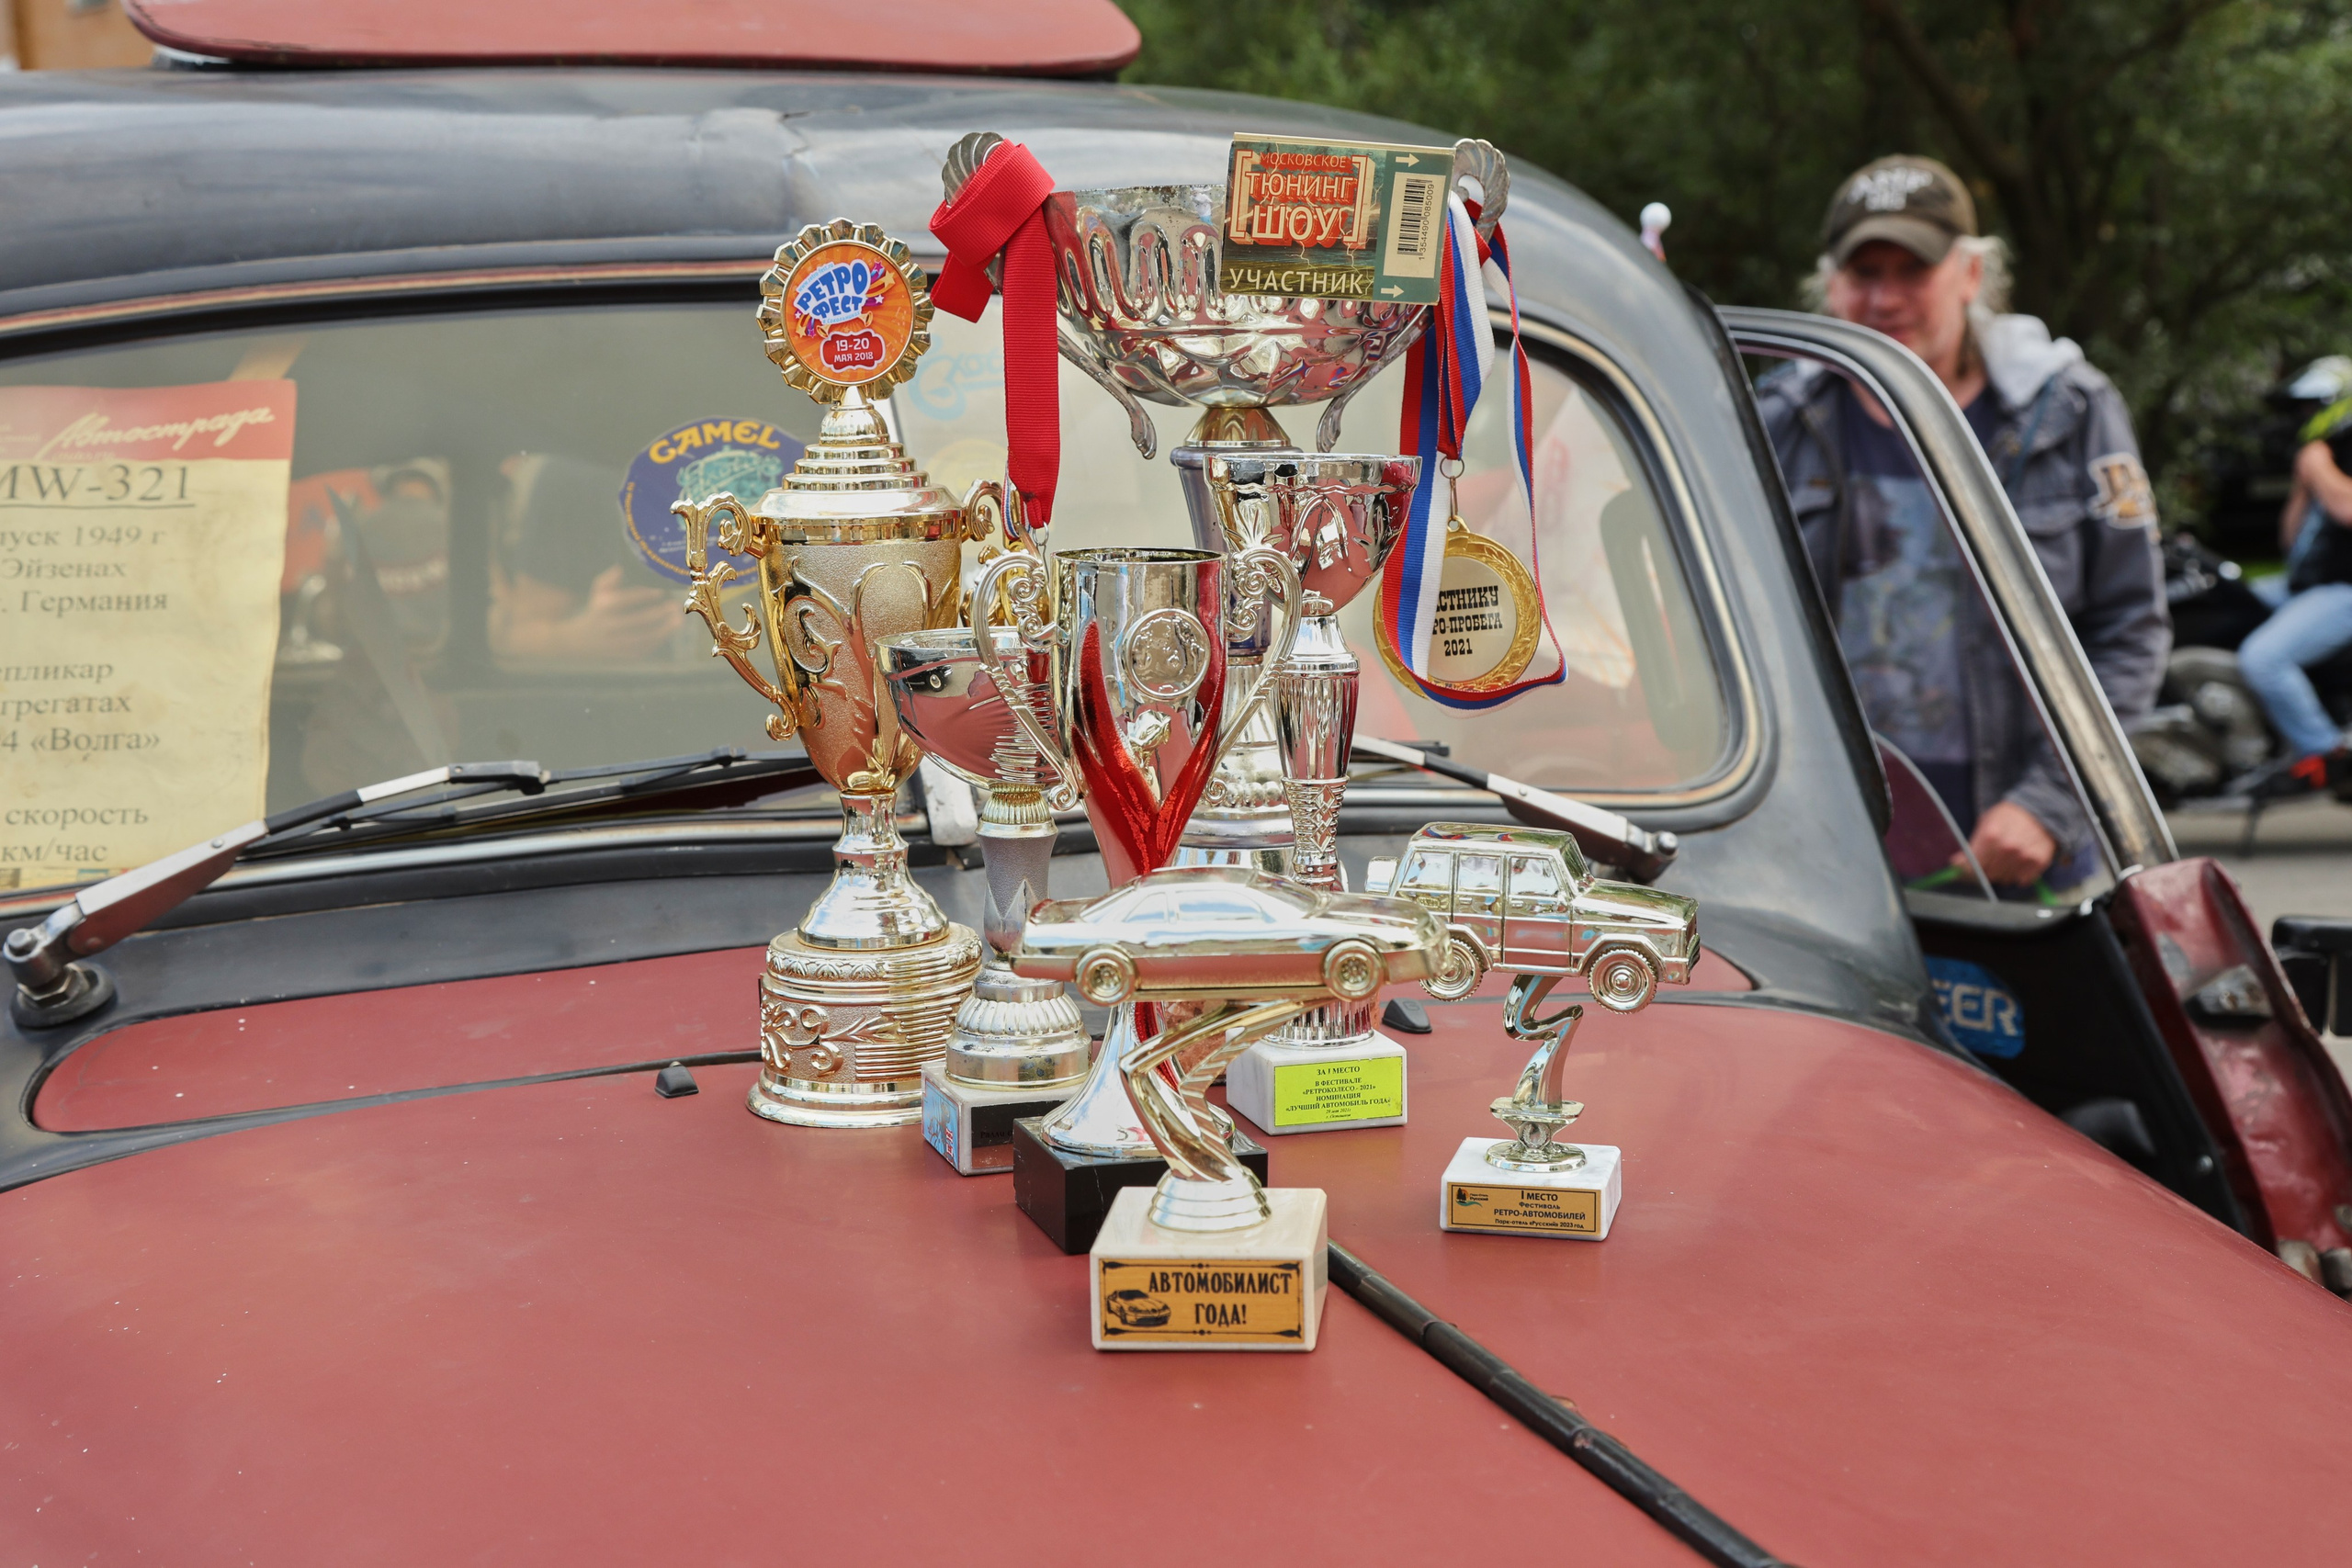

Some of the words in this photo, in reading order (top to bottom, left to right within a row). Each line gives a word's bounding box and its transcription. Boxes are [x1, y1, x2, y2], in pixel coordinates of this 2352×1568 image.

[1259, 152, 1347, 169] МОСКОВСКОЕ
[1245, 172, 1354, 199] ТЮНИНГ
[1252, 204, 1341, 241] ШОУ
[797, 262, 868, 310] РЕТРО
[1229, 267, 1364, 295] УЧАСТНИК
[811, 295, 864, 319] ФЕСТ
[835, 337, 870, 352] 19-20
[834, 353, 853, 363] МАЯ
[854, 351, 874, 361] 2018
[649, 421, 781, 464] CAMEL
[74, 525, 142, 547] 1949
[1, 558, 127, 579] Эйзенах
[20, 590, 168, 618] Германия
[1443, 637, 1473, 657] 2021
[0, 662, 115, 683] пликар
[30, 728, 161, 752] «Волга»
[5, 807, 150, 830] скорость
[1, 837, 108, 863] км/час
[1332, 1066, 1361, 1075] МЕСТО
[1321, 1077, 1363, 1087] ФЕСТИВАЛЕ
[1316, 1092, 1362, 1101] НОМИНАЦИЯ
[1321, 1100, 1369, 1109] АВТОМОБИЛЬ
[1519, 1201, 1561, 1210] Фестиваль
[1526, 1192, 1558, 1201] МЕСТО
[1494, 1209, 1586, 1220] РЕТРО-АВТОМОБИЛЕЙ
[1148, 1271, 1293, 1295] АВТОМОБИЛИСТ
[1195, 1303, 1248, 1327] ГОДА!
